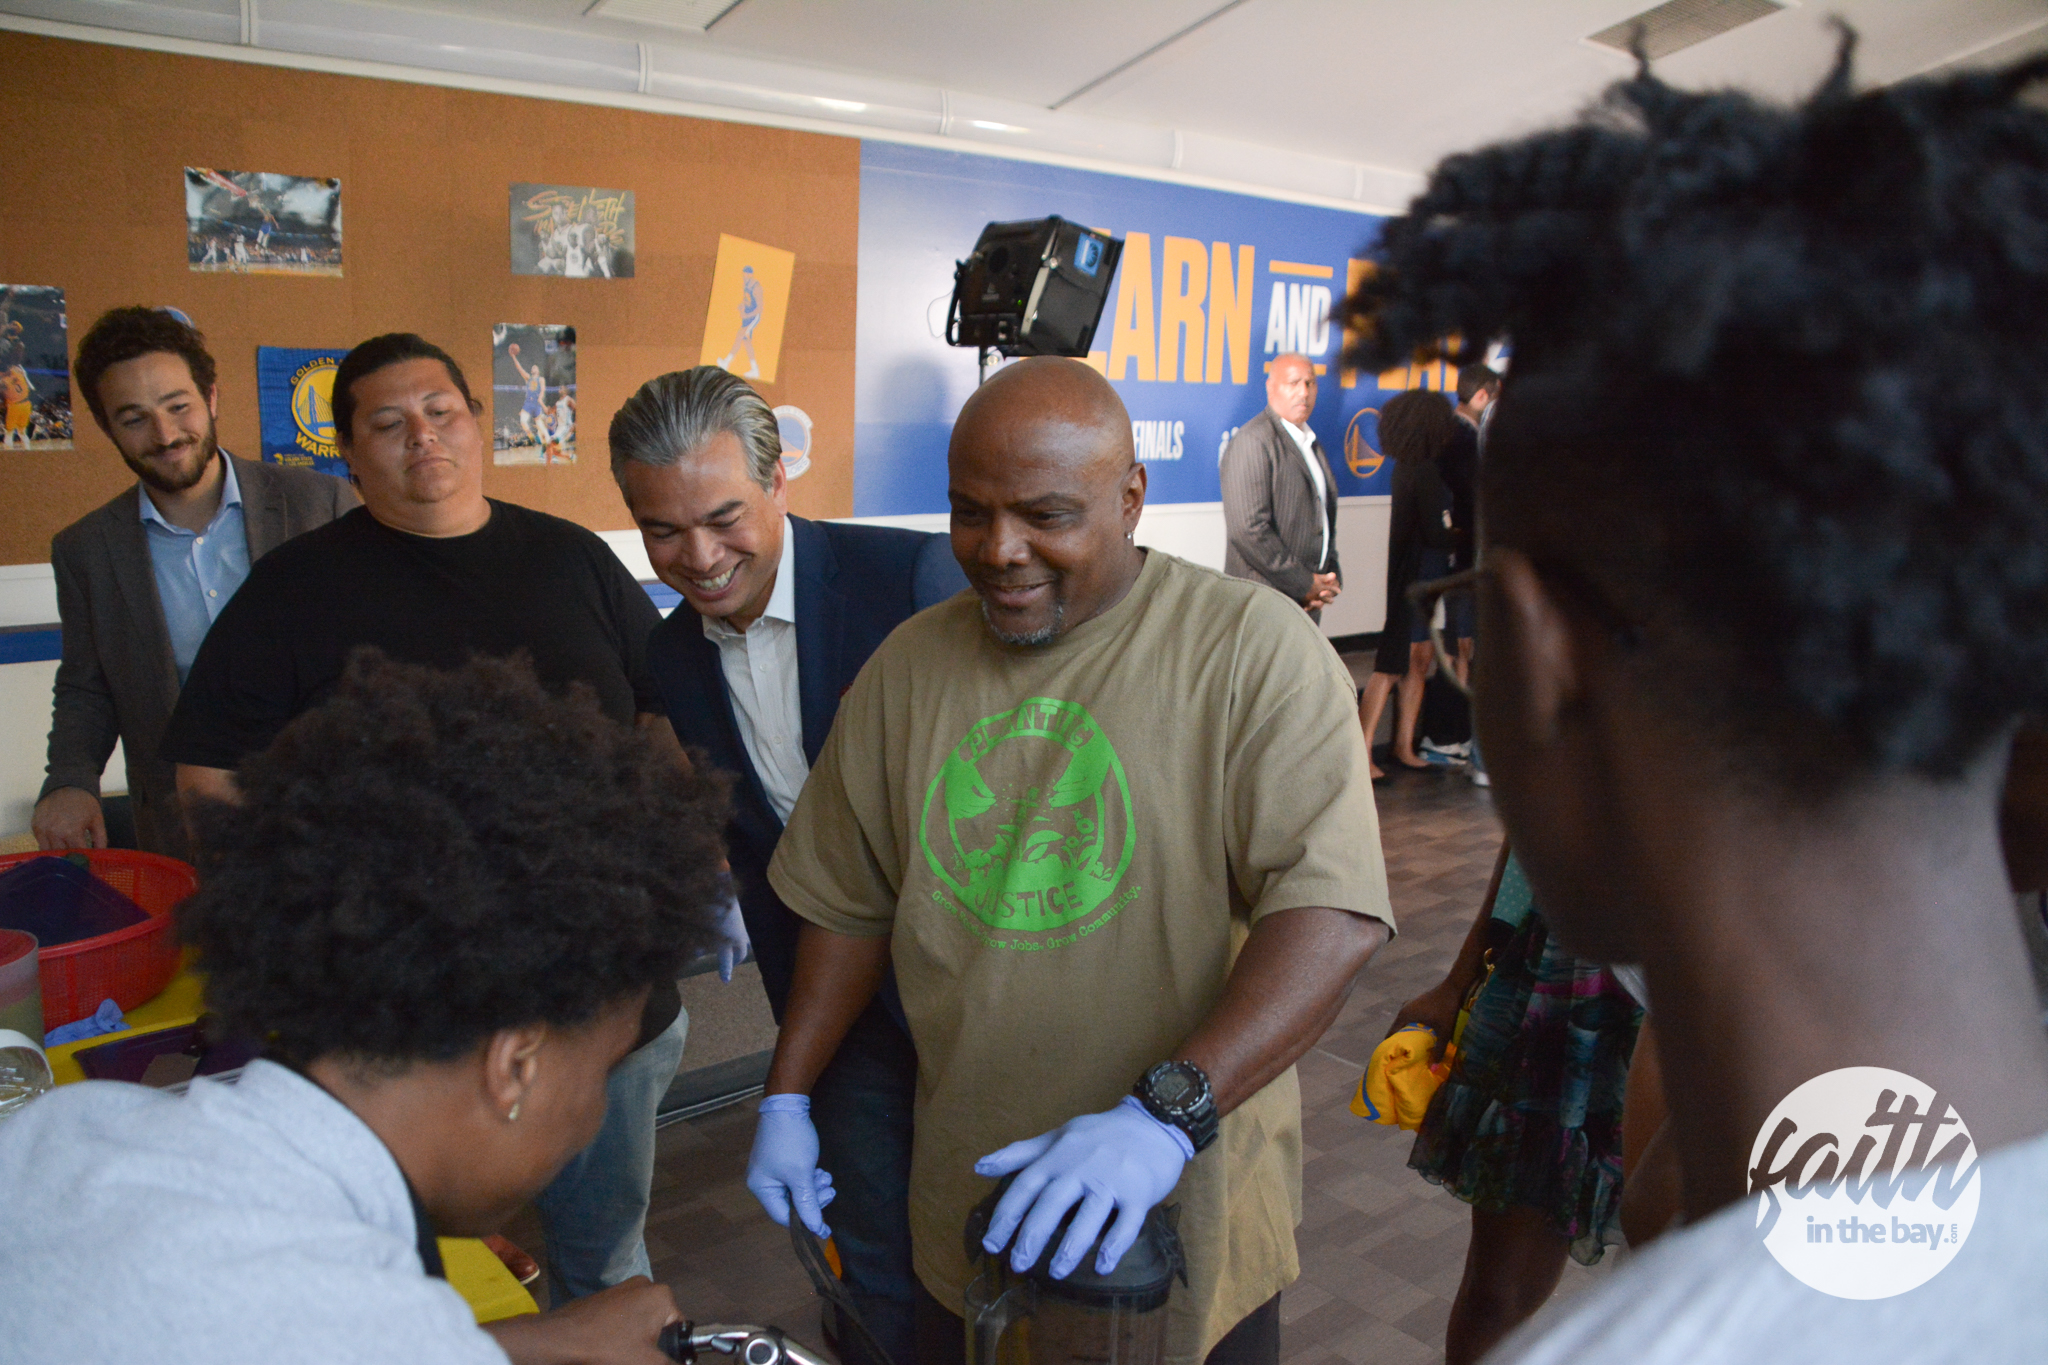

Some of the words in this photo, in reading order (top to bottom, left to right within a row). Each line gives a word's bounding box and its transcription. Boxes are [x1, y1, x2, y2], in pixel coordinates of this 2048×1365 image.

[1088, 227, 1255, 385] ARN
[1264, 281, 1332, 356] AND
[290, 357, 335, 385] GOLDEN
[295, 431, 341, 458] WARR
[1131, 420, 1185, 460] FINALS
[1010, 938, 1045, 951] Jobs.
[1046, 932, 1078, 950] Grow
[1078, 885, 1142, 937] Community.
